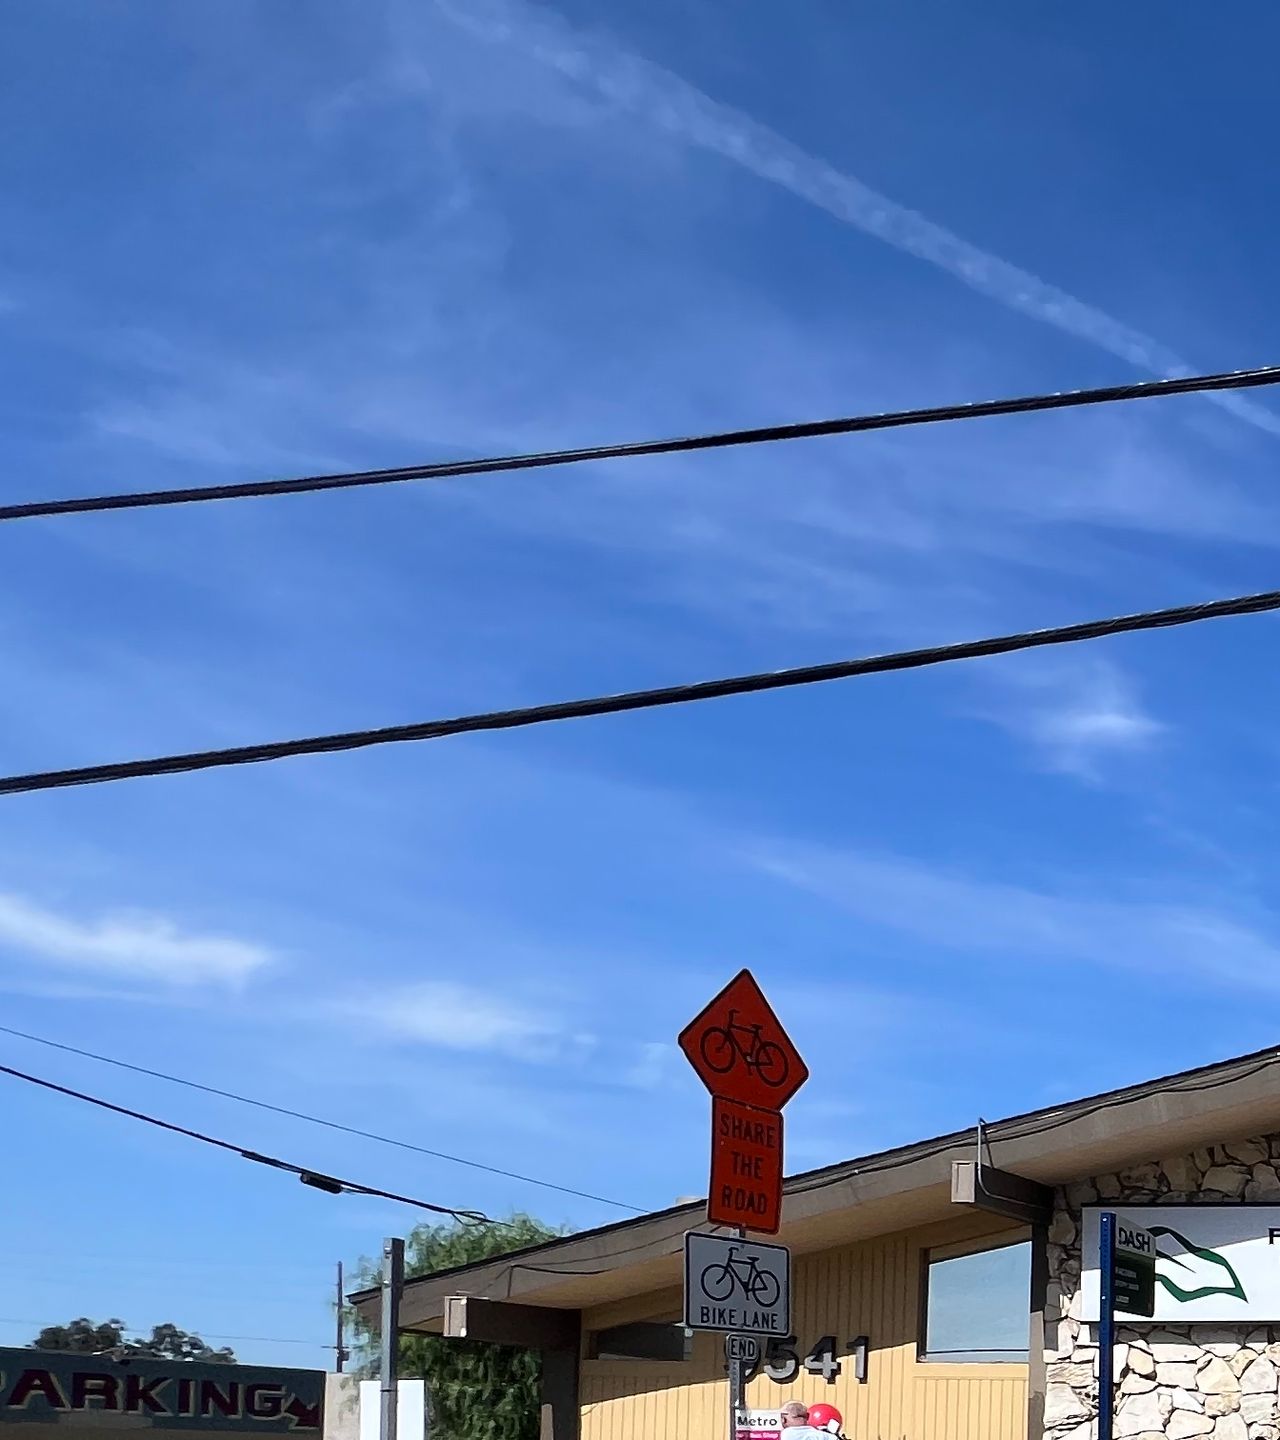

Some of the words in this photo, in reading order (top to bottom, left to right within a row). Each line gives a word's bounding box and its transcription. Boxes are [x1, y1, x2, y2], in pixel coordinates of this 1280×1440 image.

[720, 1112, 776, 1149] SHARE
[731, 1150, 763, 1181] THE
[721, 1183, 767, 1215] ROAD
[1118, 1226, 1151, 1253] DASH
[700, 1306, 737, 1327] BIKE
[742, 1309, 779, 1330] LANE
[725, 1336, 870, 1385] 541
[731, 1337, 756, 1358] END
[0, 1366, 289, 1420] ARKING
[737, 1414, 778, 1428] Metro
